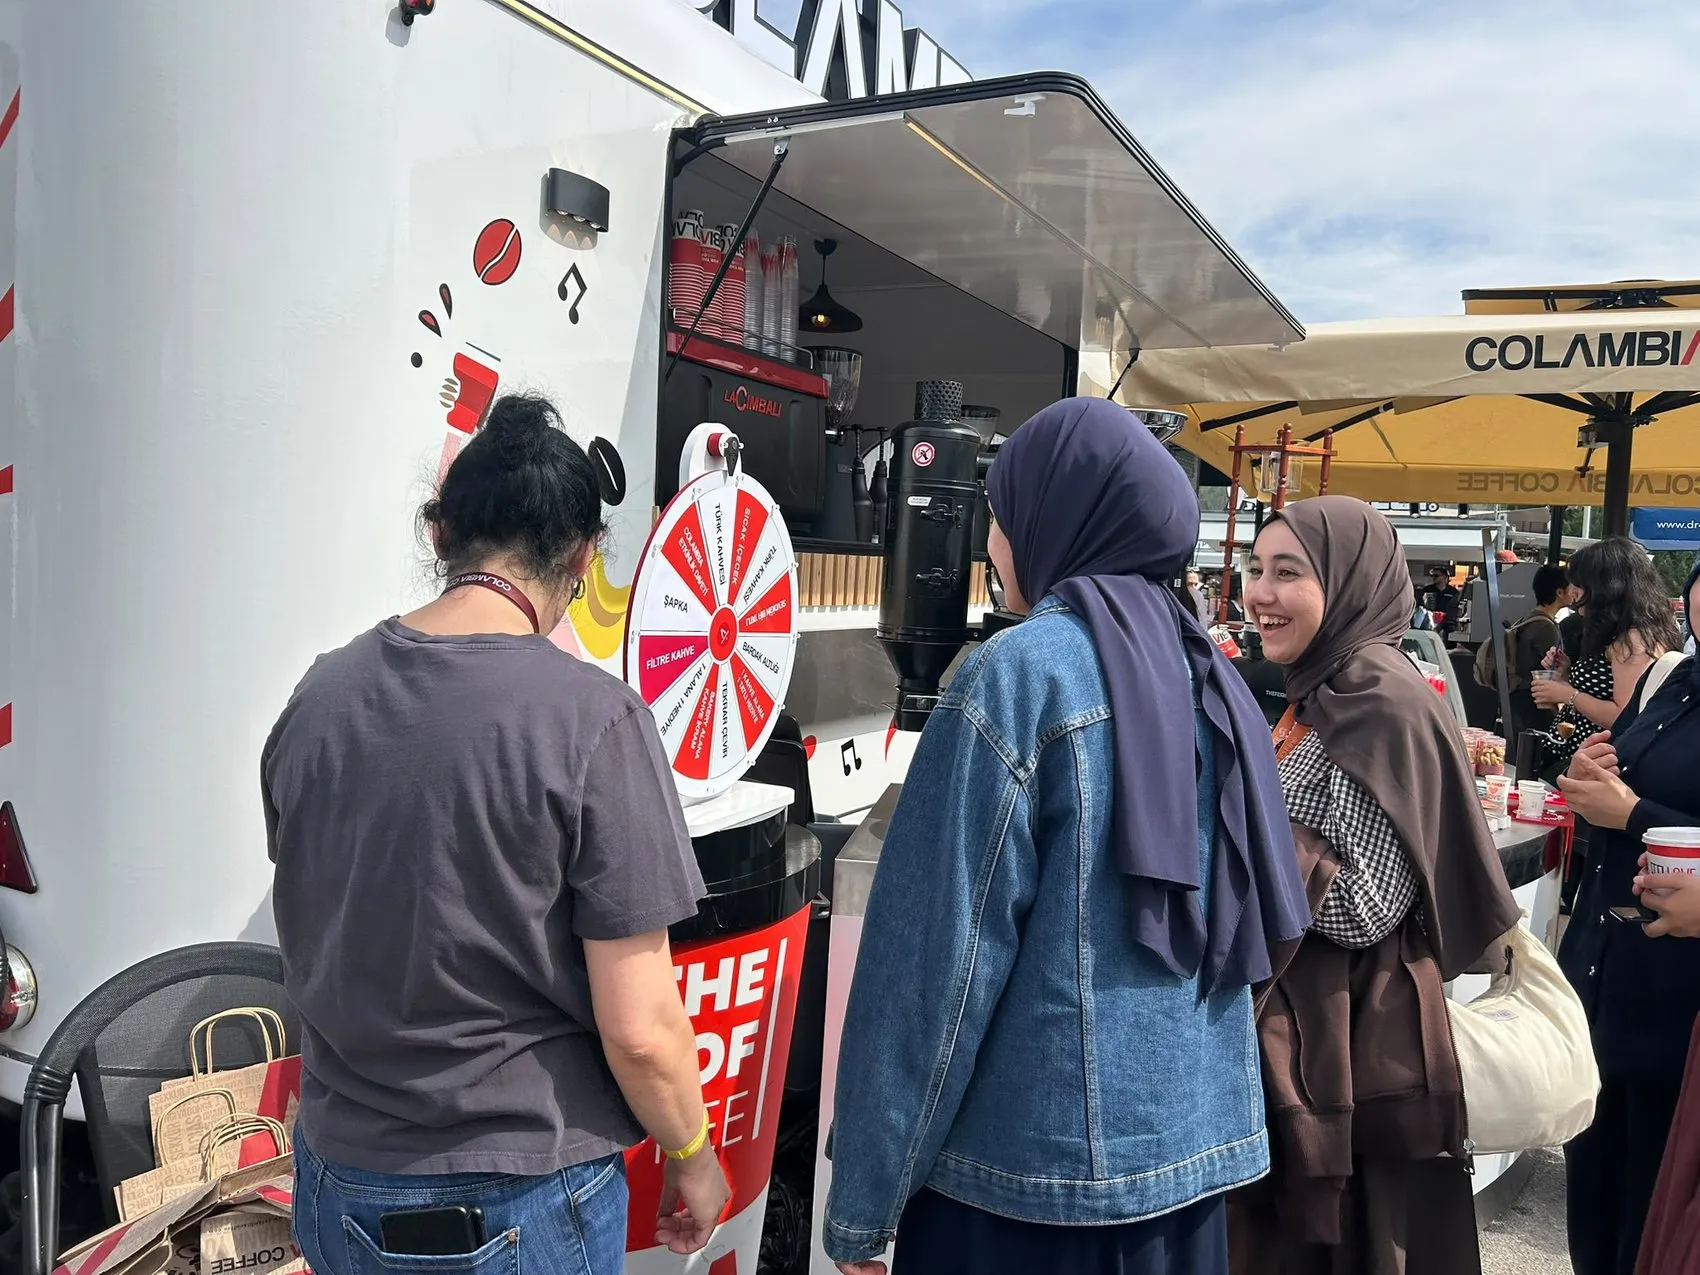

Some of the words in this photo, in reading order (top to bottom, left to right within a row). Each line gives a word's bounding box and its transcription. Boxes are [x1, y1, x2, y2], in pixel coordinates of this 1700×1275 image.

[715, 502, 723, 534] TÜRK
[740, 507, 751, 541] SICAK
[1656, 520, 1700, 529] www.dr
[717, 536, 727, 586] KAHVESİ
[732, 544, 745, 585] İÇECEK
[763, 545, 777, 568] TÜRK
[743, 566, 765, 605] KAHVESİ
[663, 594, 688, 613] ŞAPKA
[646, 652, 670, 670] FİLTRE
[671, 645, 695, 662] KAHVE
[742, 641, 763, 663] BARDAK
[684, 667, 703, 698] ALANA
[660, 701, 682, 736] HEDİYE
[698, 688, 710, 719] KAHVE
[704, 691, 716, 727] BAKERY
[694, 728, 707, 760] ALANA
[721, 726, 729, 758] ÇEVİR
[673, 948, 769, 1016] HE
[210, 1246, 285, 1275] COFFEE
